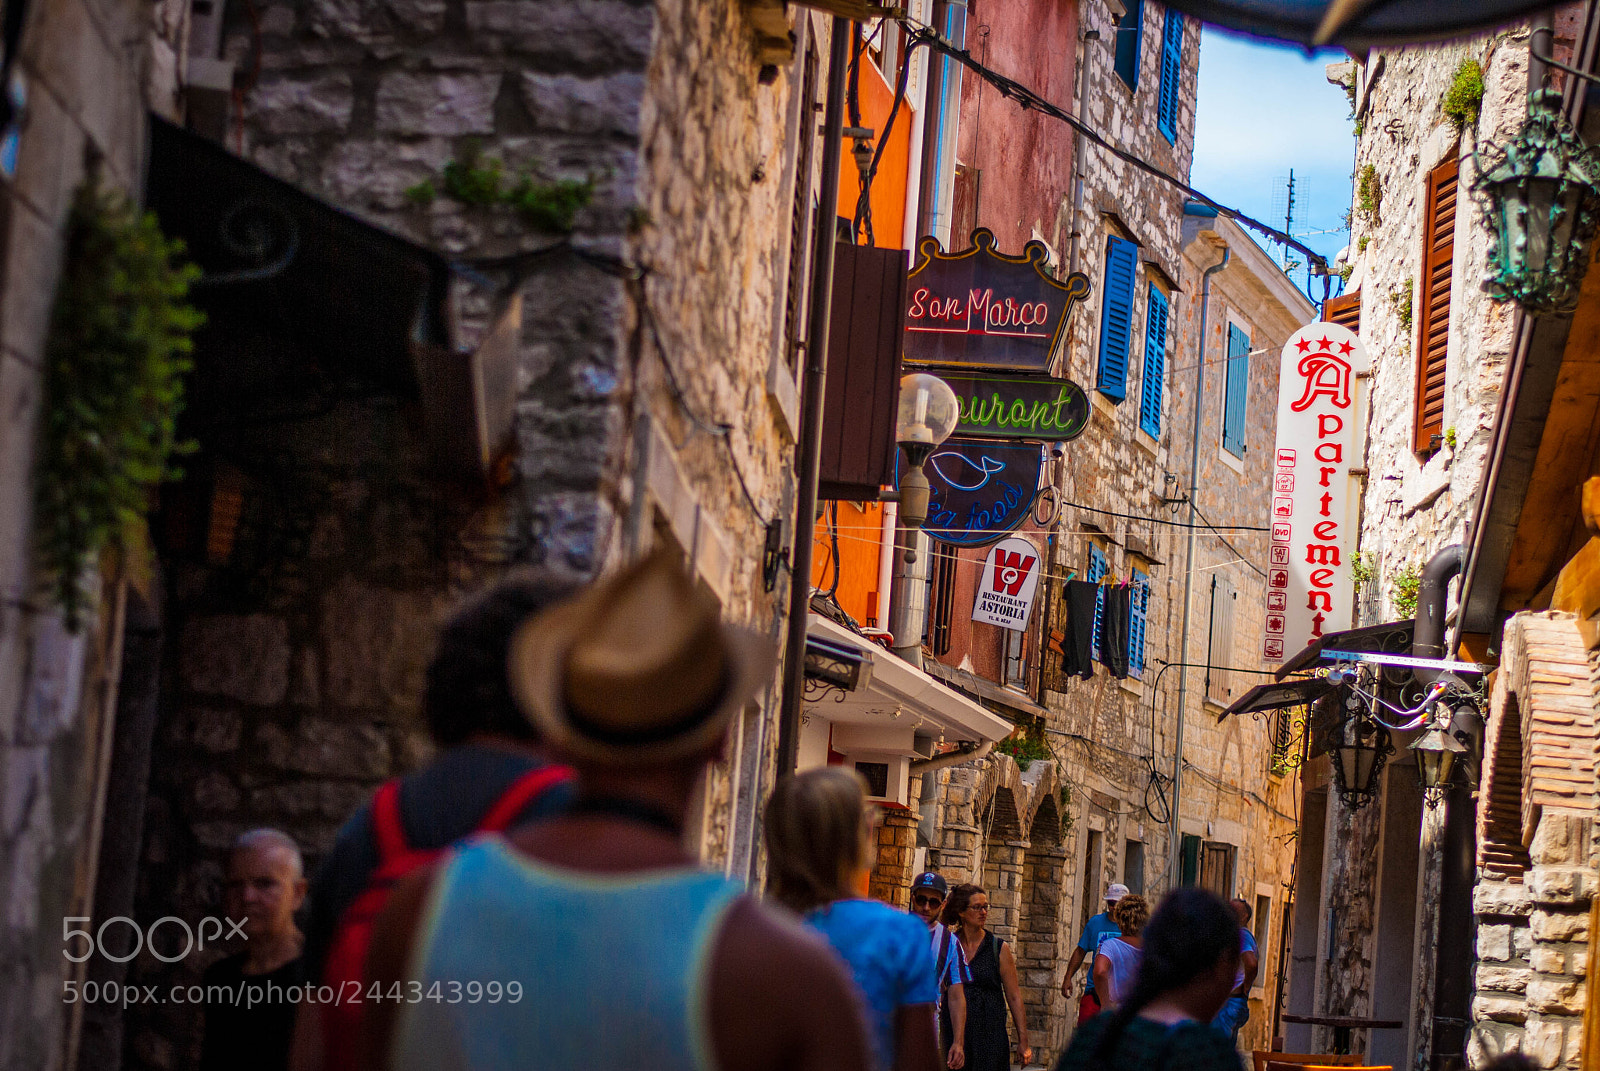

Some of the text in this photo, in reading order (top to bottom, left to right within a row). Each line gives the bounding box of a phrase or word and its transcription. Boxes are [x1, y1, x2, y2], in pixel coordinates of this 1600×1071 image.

[908, 287, 964, 321] San
[1274, 528, 1289, 536] DVD
[1274, 548, 1286, 556] SAT
[982, 591, 1027, 609] RESTAURANT
[979, 600, 1025, 620] ASTORIA
